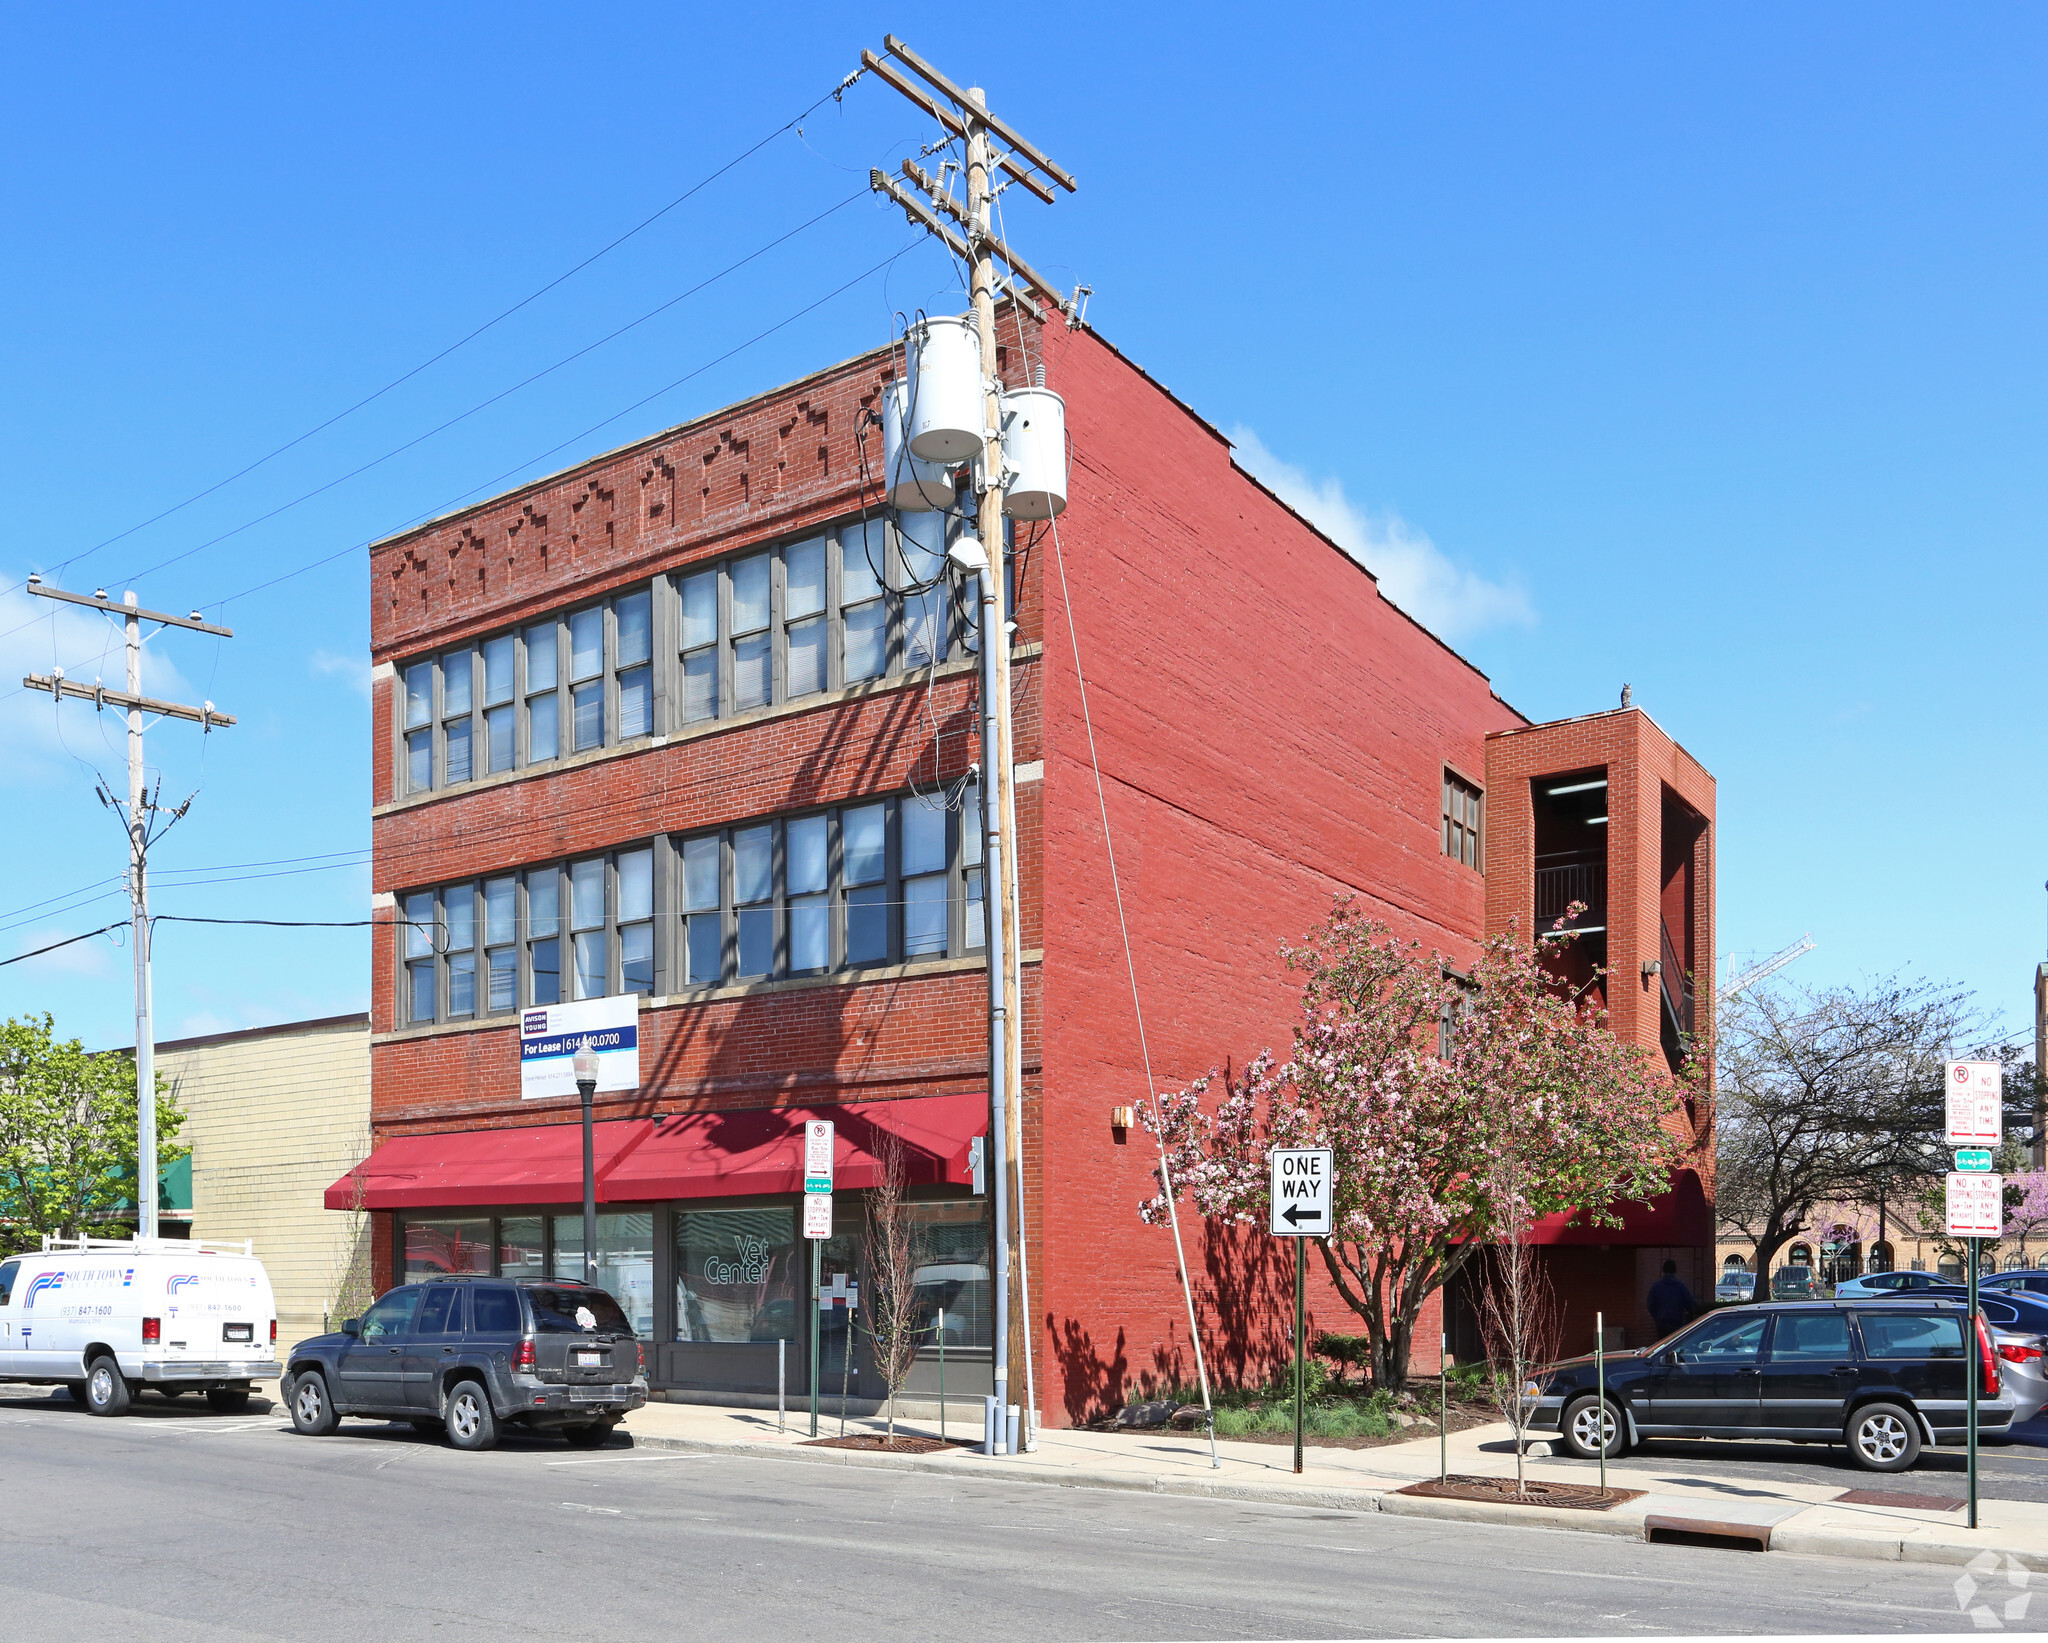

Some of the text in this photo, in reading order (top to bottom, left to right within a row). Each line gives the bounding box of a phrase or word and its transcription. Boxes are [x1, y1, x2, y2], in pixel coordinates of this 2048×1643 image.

[525, 1014, 546, 1022] AVISON
[525, 1023, 546, 1031] YOUNG
[524, 1032, 620, 1055] For Lease 61440.0700
[1981, 1077, 1992, 1086] NO
[1975, 1091, 1998, 1101] STOPPING
[1979, 1116, 1995, 1125] TIME
[1283, 1157, 1320, 1175] ONE
[1956, 1179, 1967, 1188] NO
[1982, 1179, 1993, 1189] NO
[1282, 1180, 1321, 1198] WAY
[1950, 1189, 1973, 1199] STOPPING
[1975, 1190, 1998, 1200] STOPPING
[807, 1206, 829, 1214] STOPPING
[1979, 1212, 1995, 1220] TIME
[734, 1235, 768, 1263] Vet
[704, 1255, 768, 1284] Center
[64, 1270, 95, 1282] SOUTH
[96, 1269, 124, 1281] TOWN
[61, 1305, 112, 1317] (937) 847-1600
[207, 1304, 242, 1312] 847-1600
